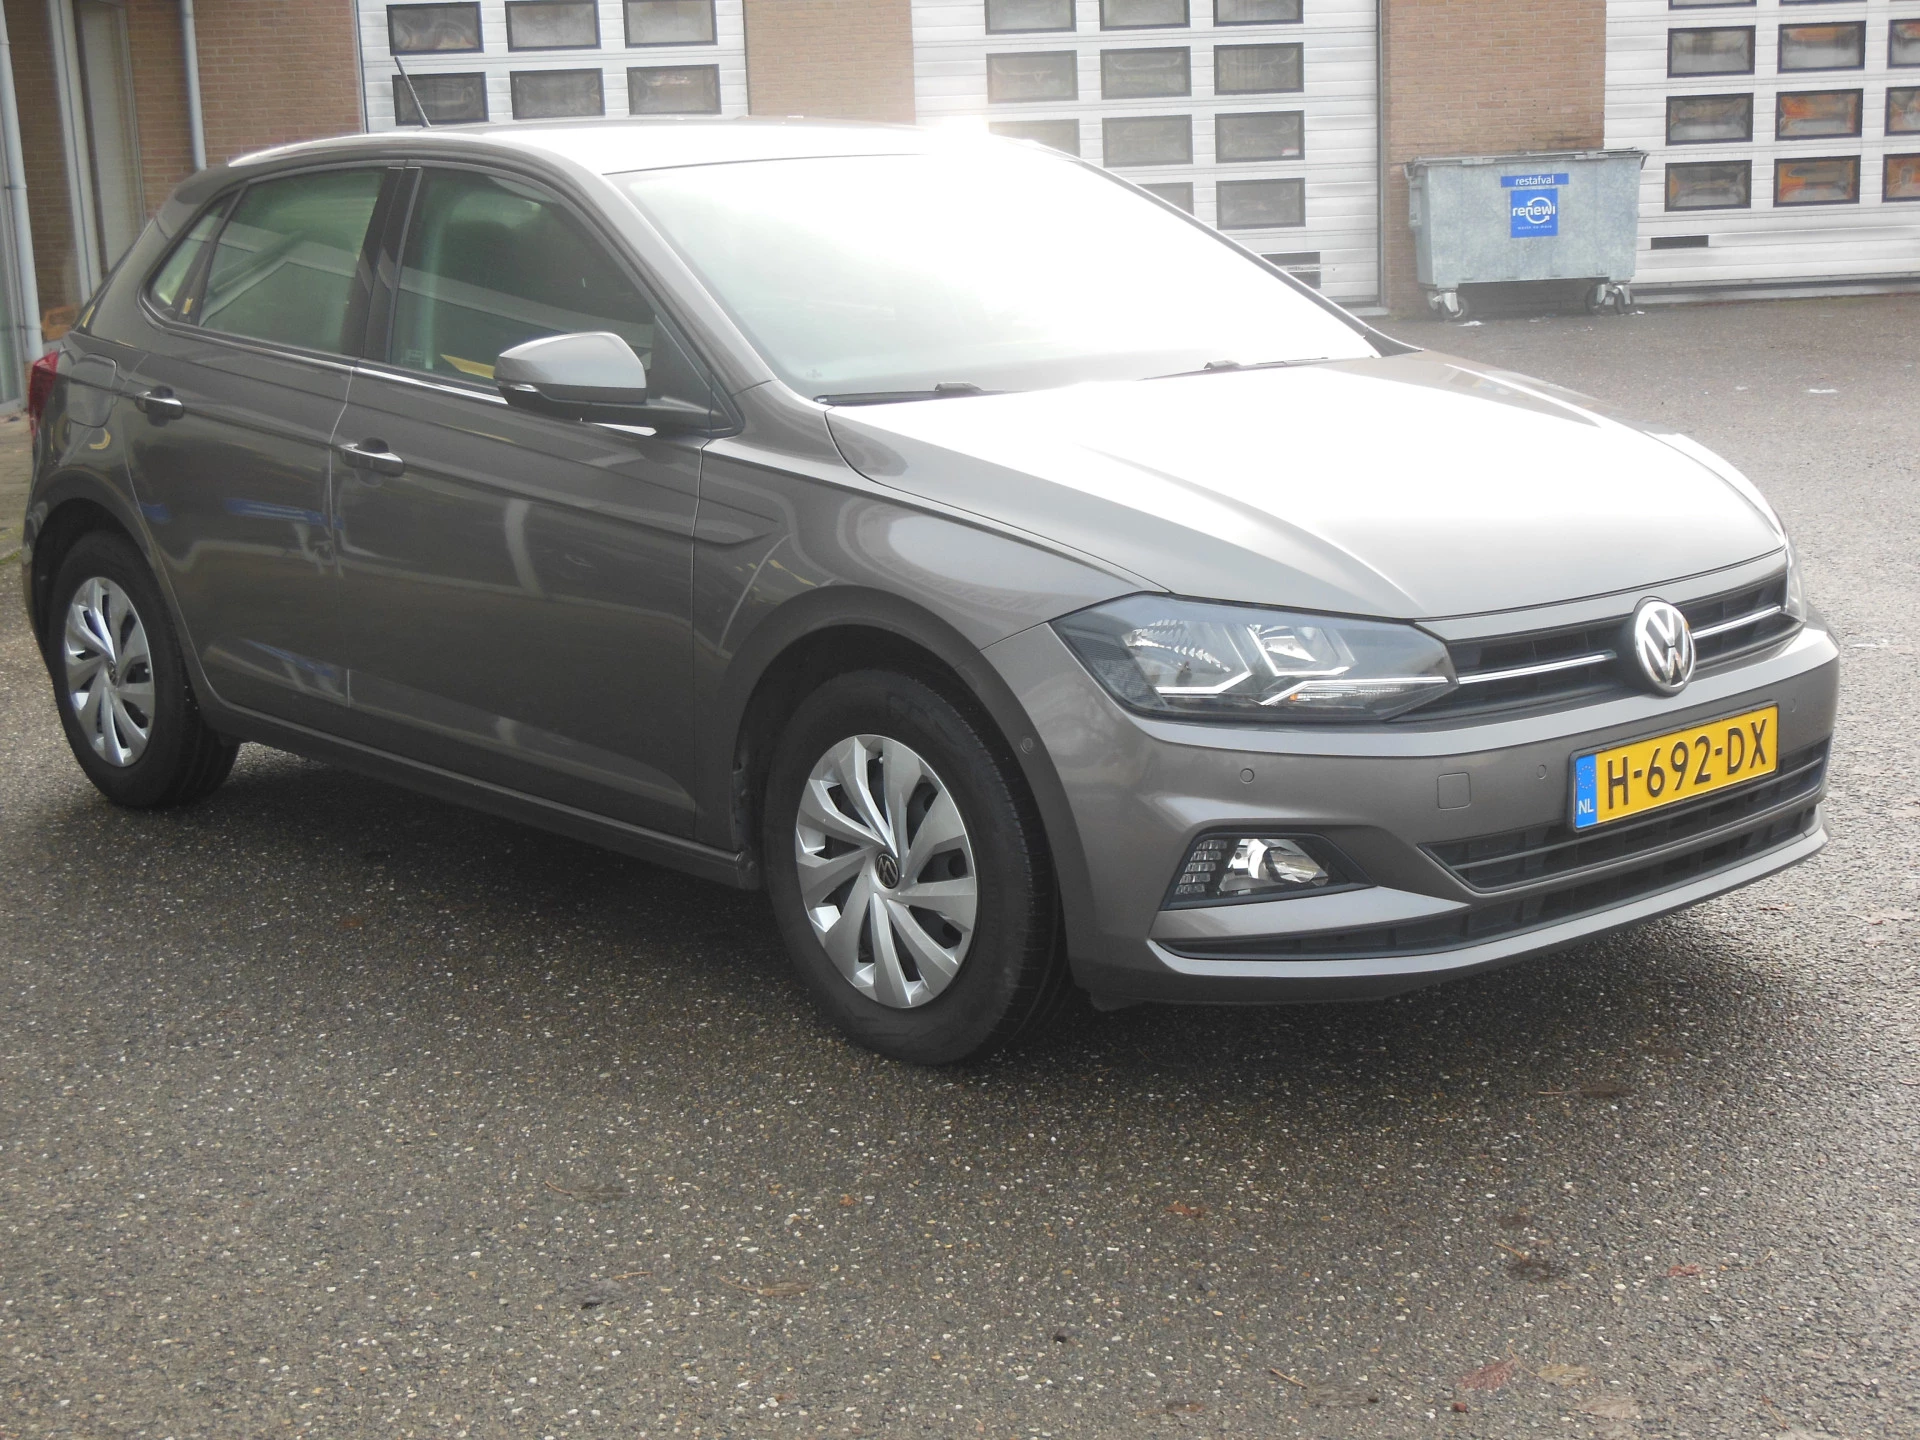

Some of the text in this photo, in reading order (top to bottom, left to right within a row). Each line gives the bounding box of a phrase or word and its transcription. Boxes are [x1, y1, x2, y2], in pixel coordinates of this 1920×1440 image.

[1515, 174, 1555, 186] restafval
[1512, 204, 1556, 217] renewi
[1607, 718, 1767, 810] H-692-DX
[1578, 799, 1594, 815] NL
